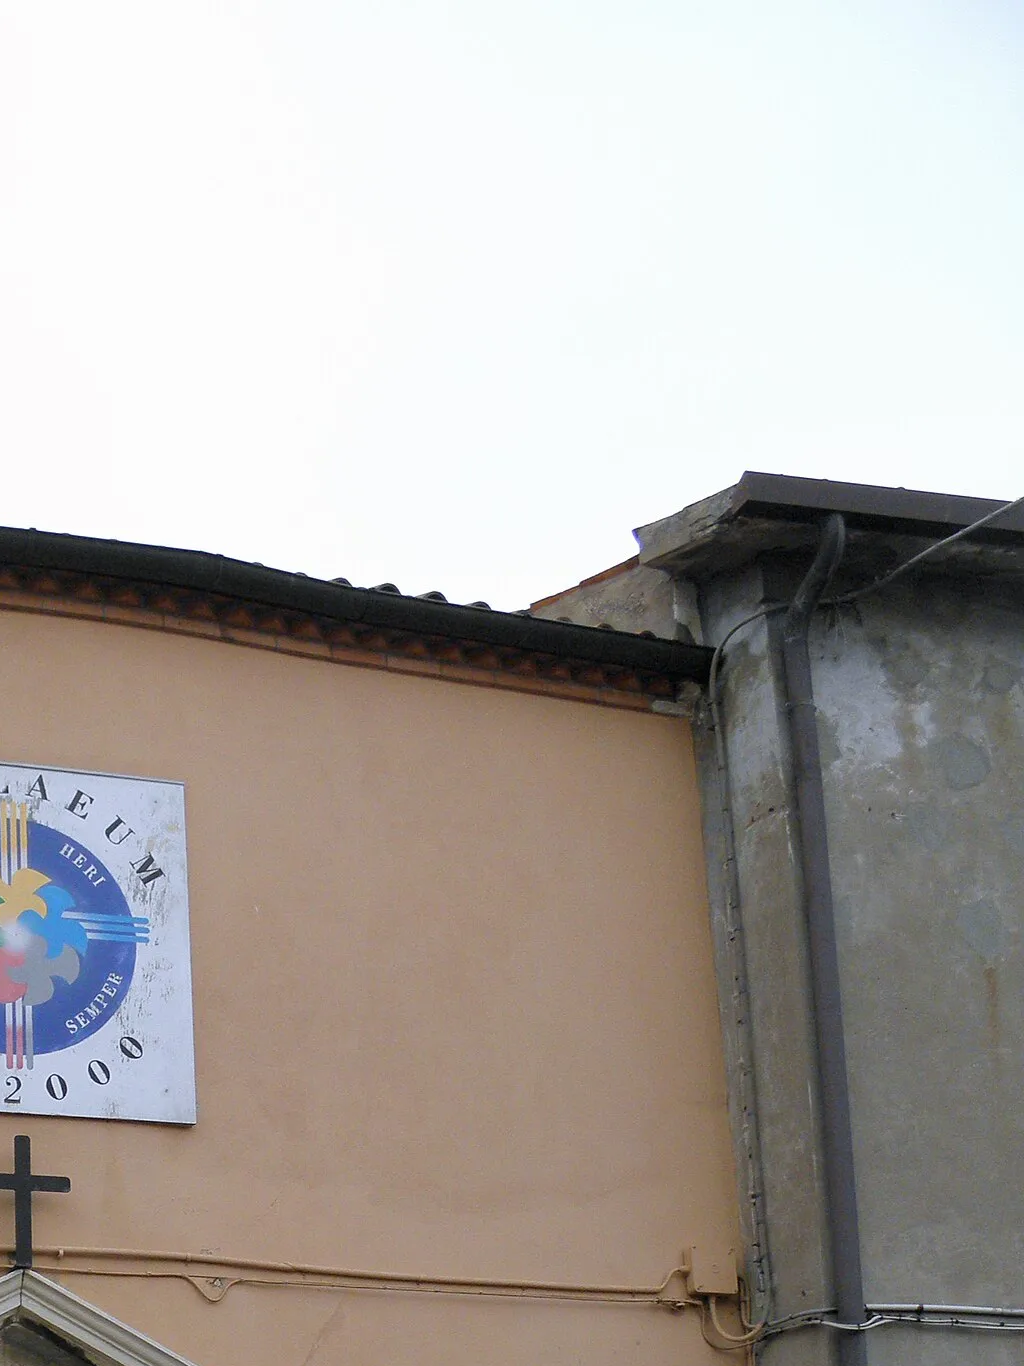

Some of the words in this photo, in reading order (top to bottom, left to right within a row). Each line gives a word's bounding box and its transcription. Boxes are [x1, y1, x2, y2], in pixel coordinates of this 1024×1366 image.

[59, 843, 106, 887] HERI
[64, 971, 124, 1035] SEMPER
[3, 1035, 143, 1104] 2000
